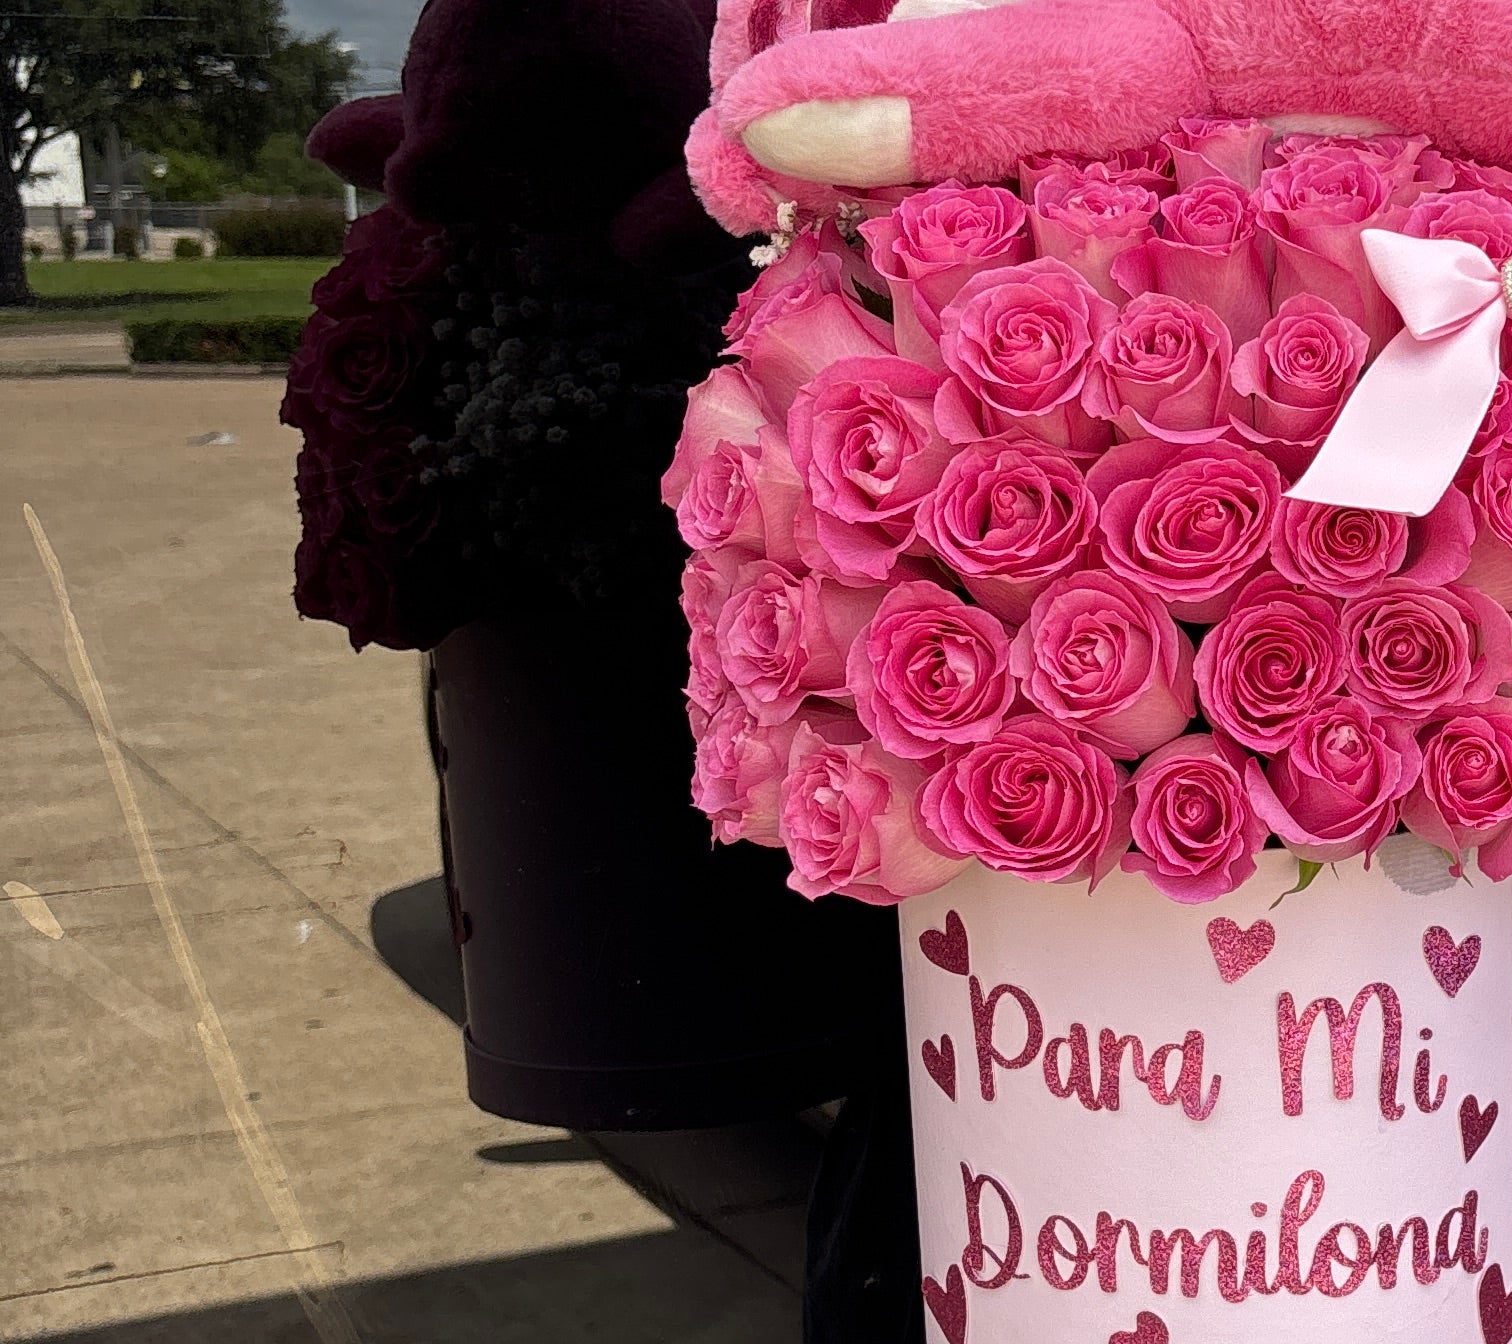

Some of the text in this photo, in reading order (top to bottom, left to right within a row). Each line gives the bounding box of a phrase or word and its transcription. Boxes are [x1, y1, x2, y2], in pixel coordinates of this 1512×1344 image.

[968, 974, 1448, 1122] Para Mi
[959, 1159, 1489, 1304] Dormilona
